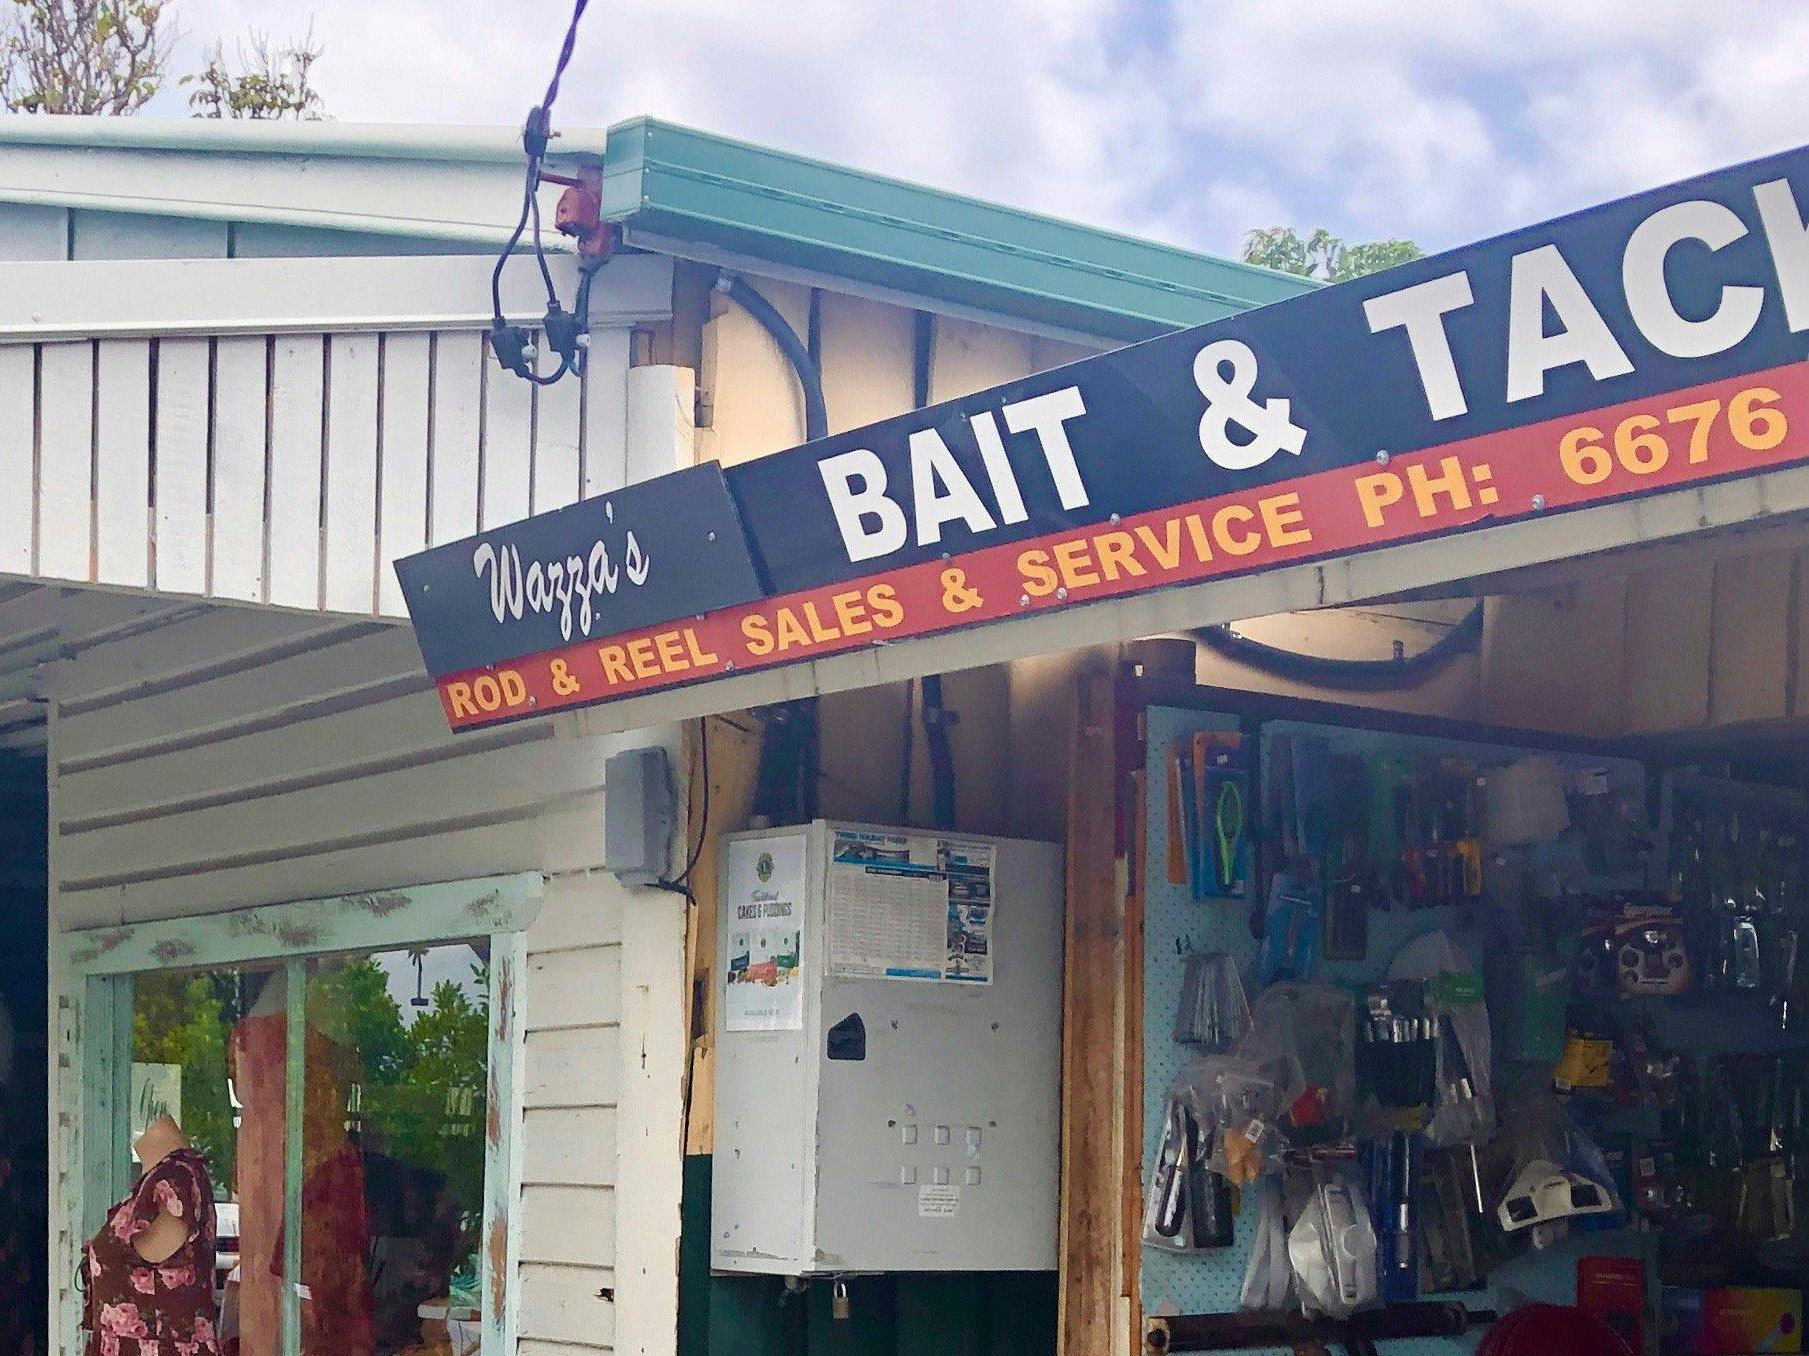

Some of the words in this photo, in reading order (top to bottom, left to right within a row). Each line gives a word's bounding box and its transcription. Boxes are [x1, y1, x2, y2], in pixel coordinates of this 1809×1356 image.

[447, 669, 526, 718] ROD
[550, 658, 580, 696] &
[598, 630, 718, 686] REEL
[740, 583, 905, 656] SALES
[940, 569, 984, 612] &
[1017, 493, 1313, 597] SERVICE
[1354, 463, 1500, 528] PH:
[1559, 388, 1789, 485] 6676
[817, 386, 1091, 563] BAIT
[1192, 340, 1307, 471] &
[475, 501, 651, 641] Wazza's
